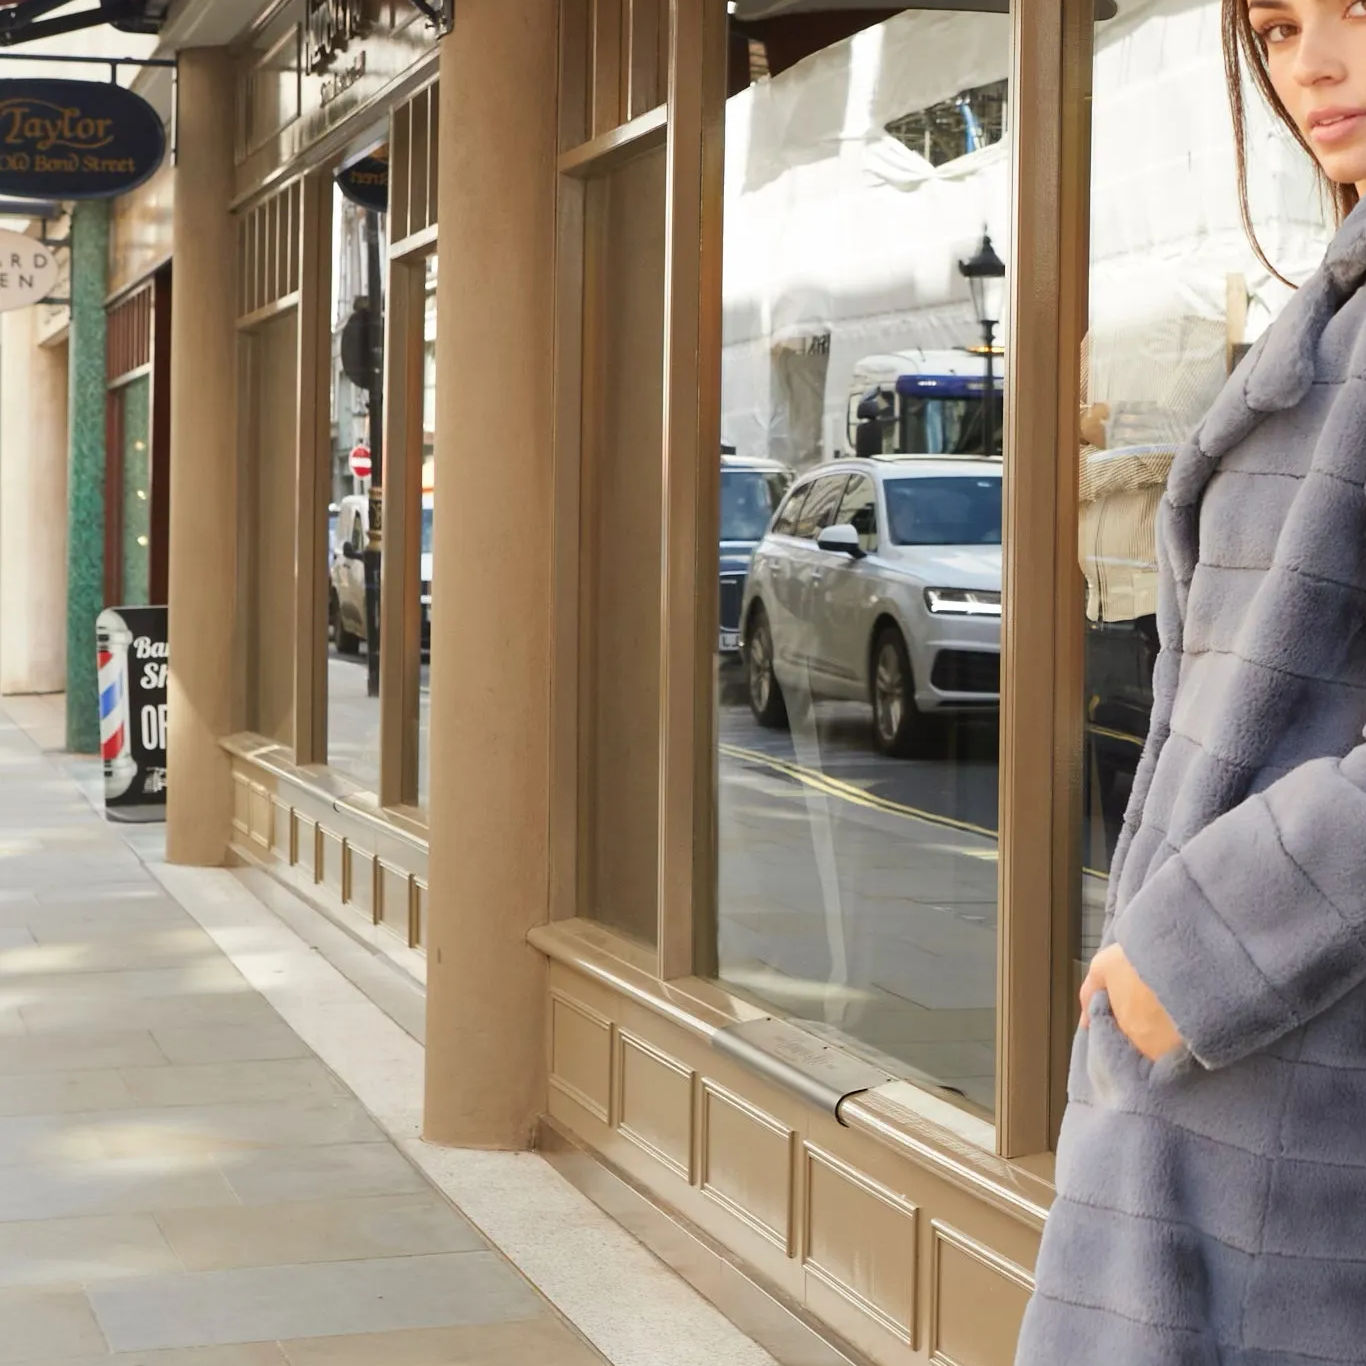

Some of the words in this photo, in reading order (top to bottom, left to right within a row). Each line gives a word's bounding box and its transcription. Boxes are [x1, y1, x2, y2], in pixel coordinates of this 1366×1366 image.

[2, 102, 114, 150] Taylor
[34, 152, 79, 172] Bond
[82, 155, 136, 174] Street
[0, 252, 48, 269] RD
